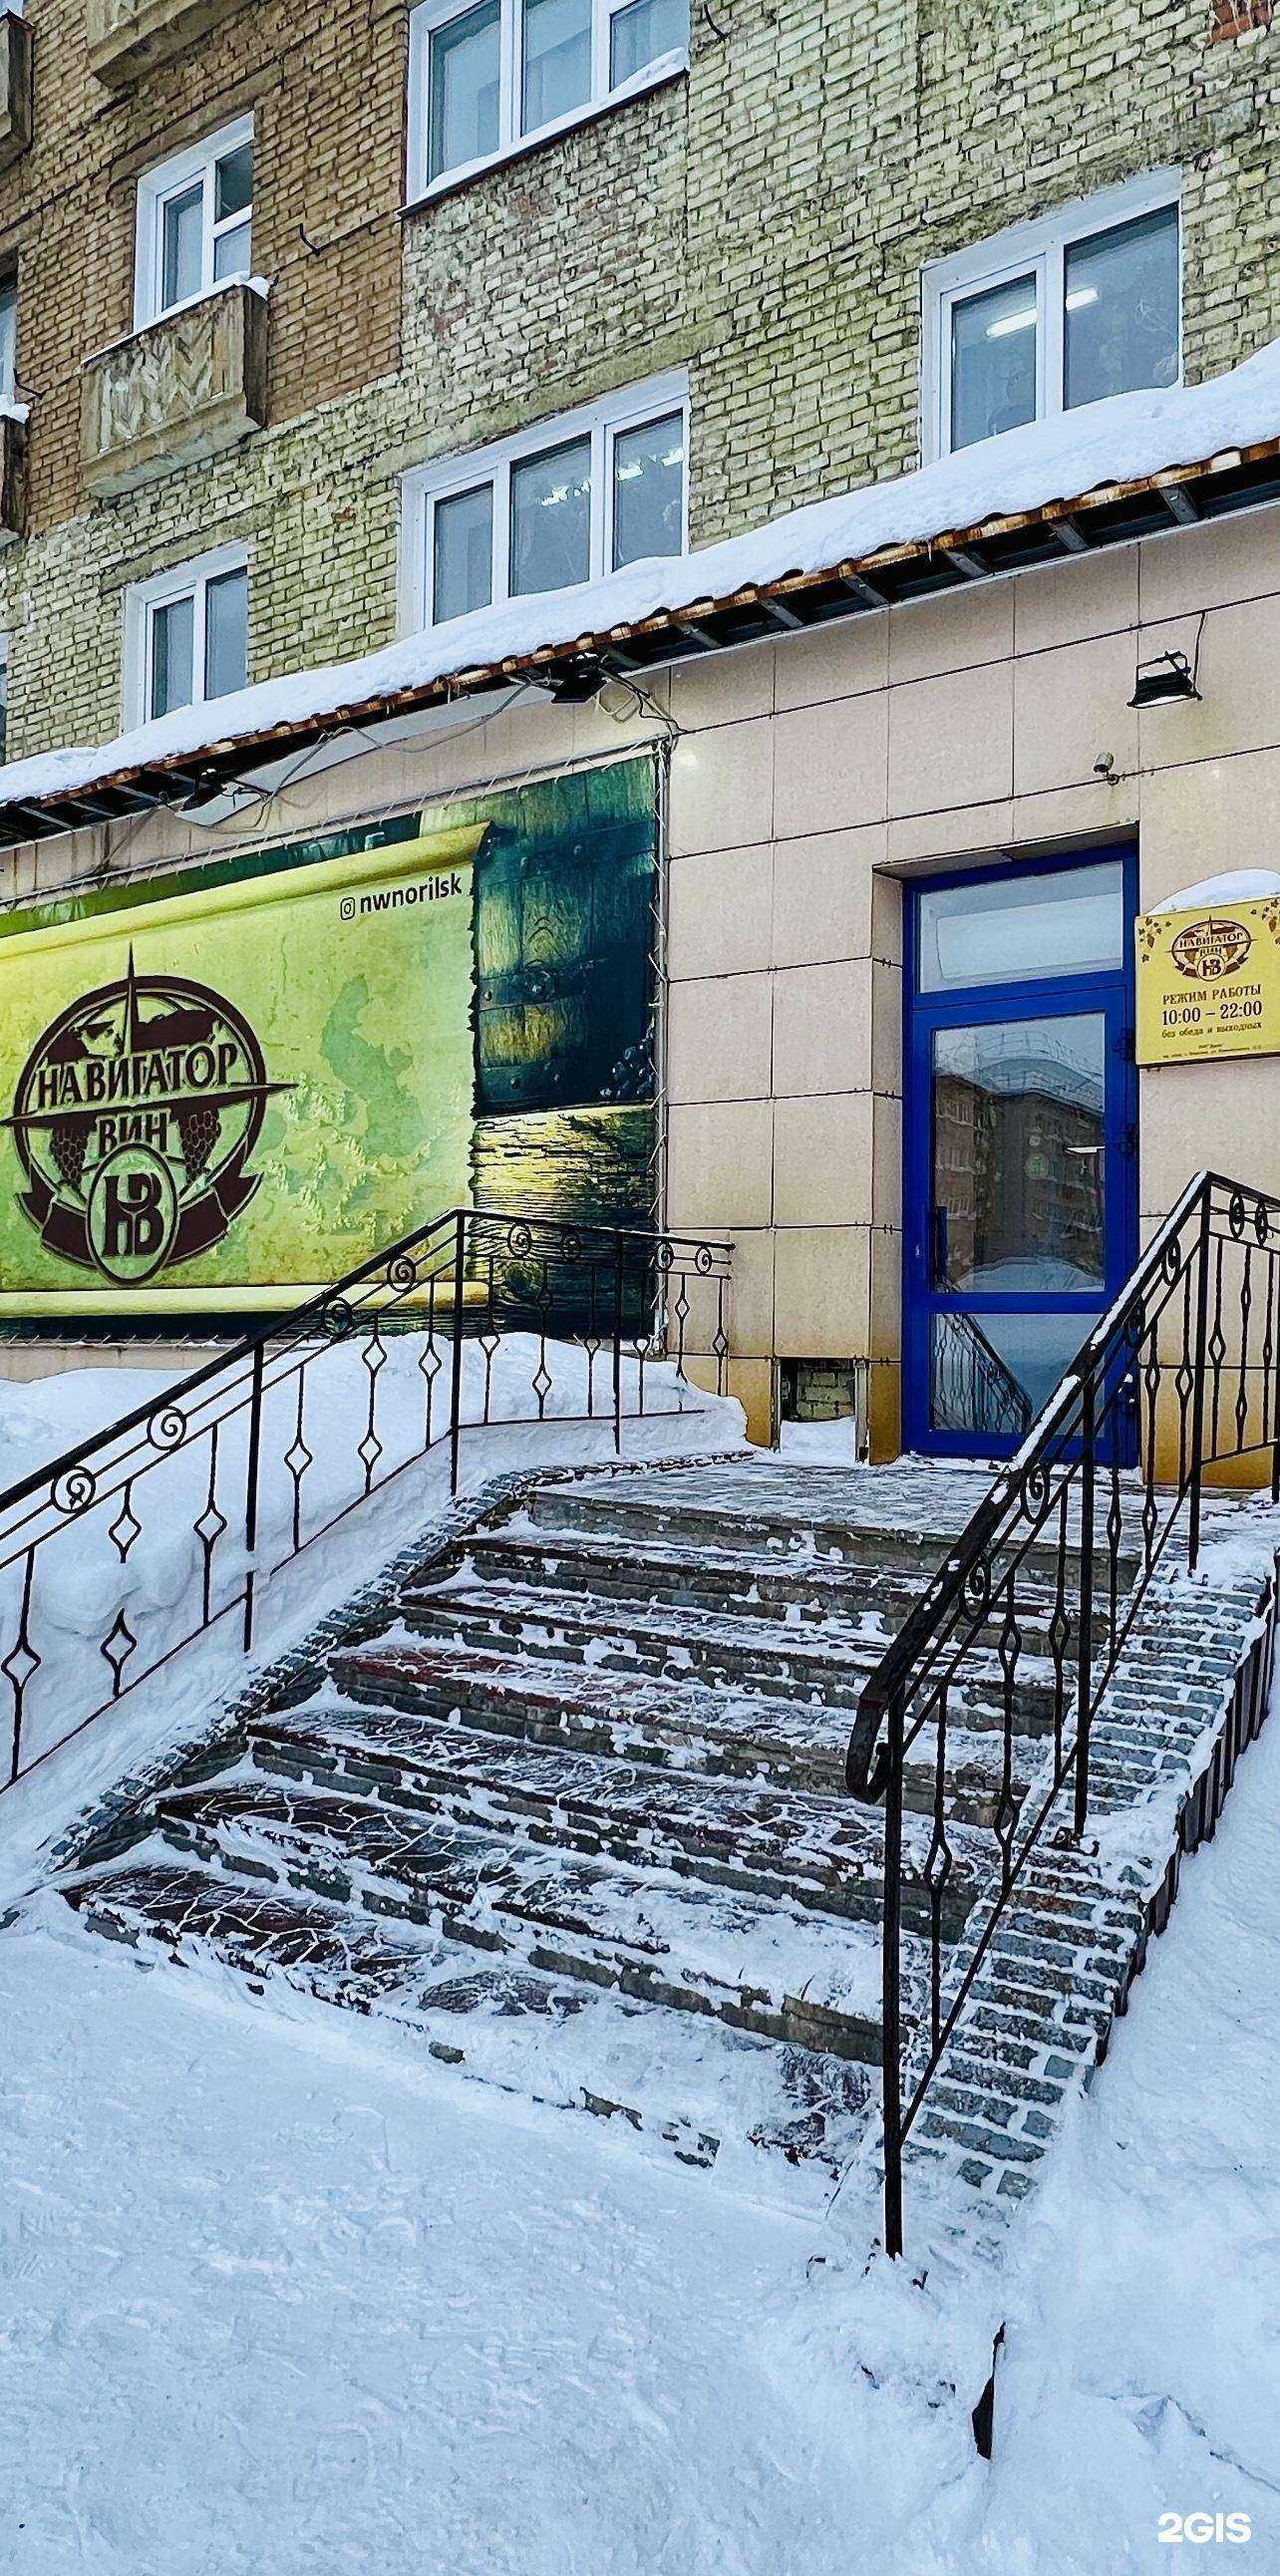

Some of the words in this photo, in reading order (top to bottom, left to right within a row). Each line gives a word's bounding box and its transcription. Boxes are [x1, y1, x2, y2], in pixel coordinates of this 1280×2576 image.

[360, 872, 463, 914] nwnorilsk
[1179, 931, 1243, 948] НАВИГАТОР
[1162, 990, 1207, 1006] РЕЖИМ
[1212, 984, 1262, 1000] РАБОТЫ
[1162, 1007, 1201, 1026] 10:00
[1220, 1000, 1263, 1020] 22:00
[1161, 1029, 1175, 1039] без
[1179, 1027, 1203, 1037] обеда
[1216, 1022, 1262, 1033] выходных
[37, 1042, 239, 1109] НАВИГАТОР
[98, 1111, 169, 1156] ВИН
